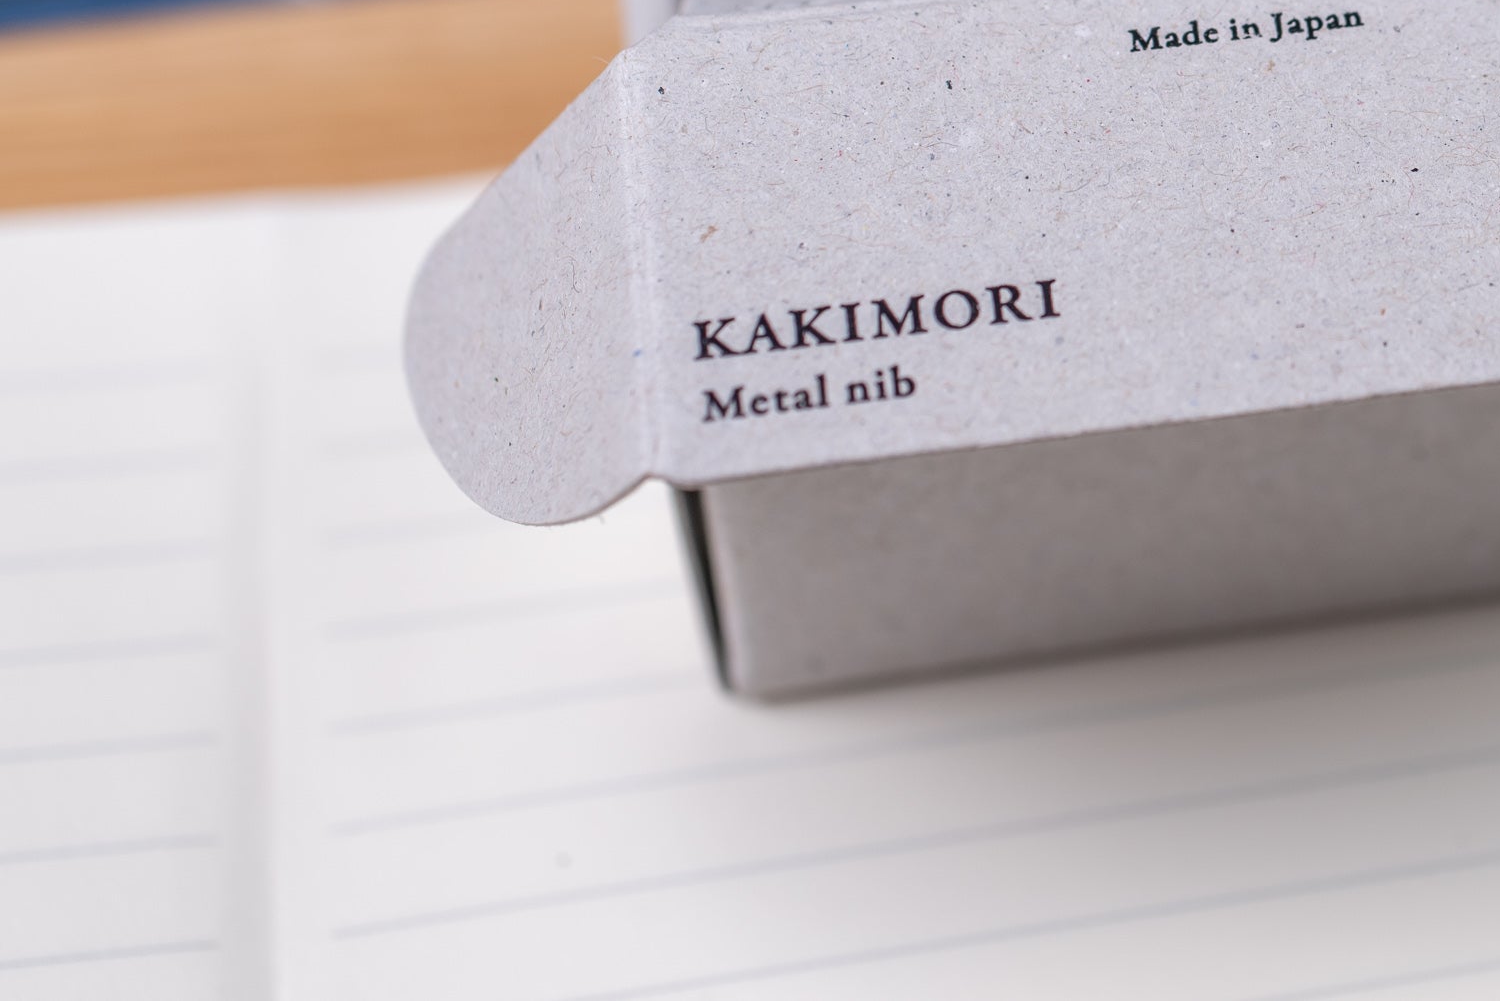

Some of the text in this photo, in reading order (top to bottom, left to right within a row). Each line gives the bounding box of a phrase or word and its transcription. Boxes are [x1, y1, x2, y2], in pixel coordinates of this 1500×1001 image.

[1127, 9, 1366, 53] Made in Japan
[692, 277, 1062, 361] KAKIMORI
[703, 364, 917, 423] Metal nib
